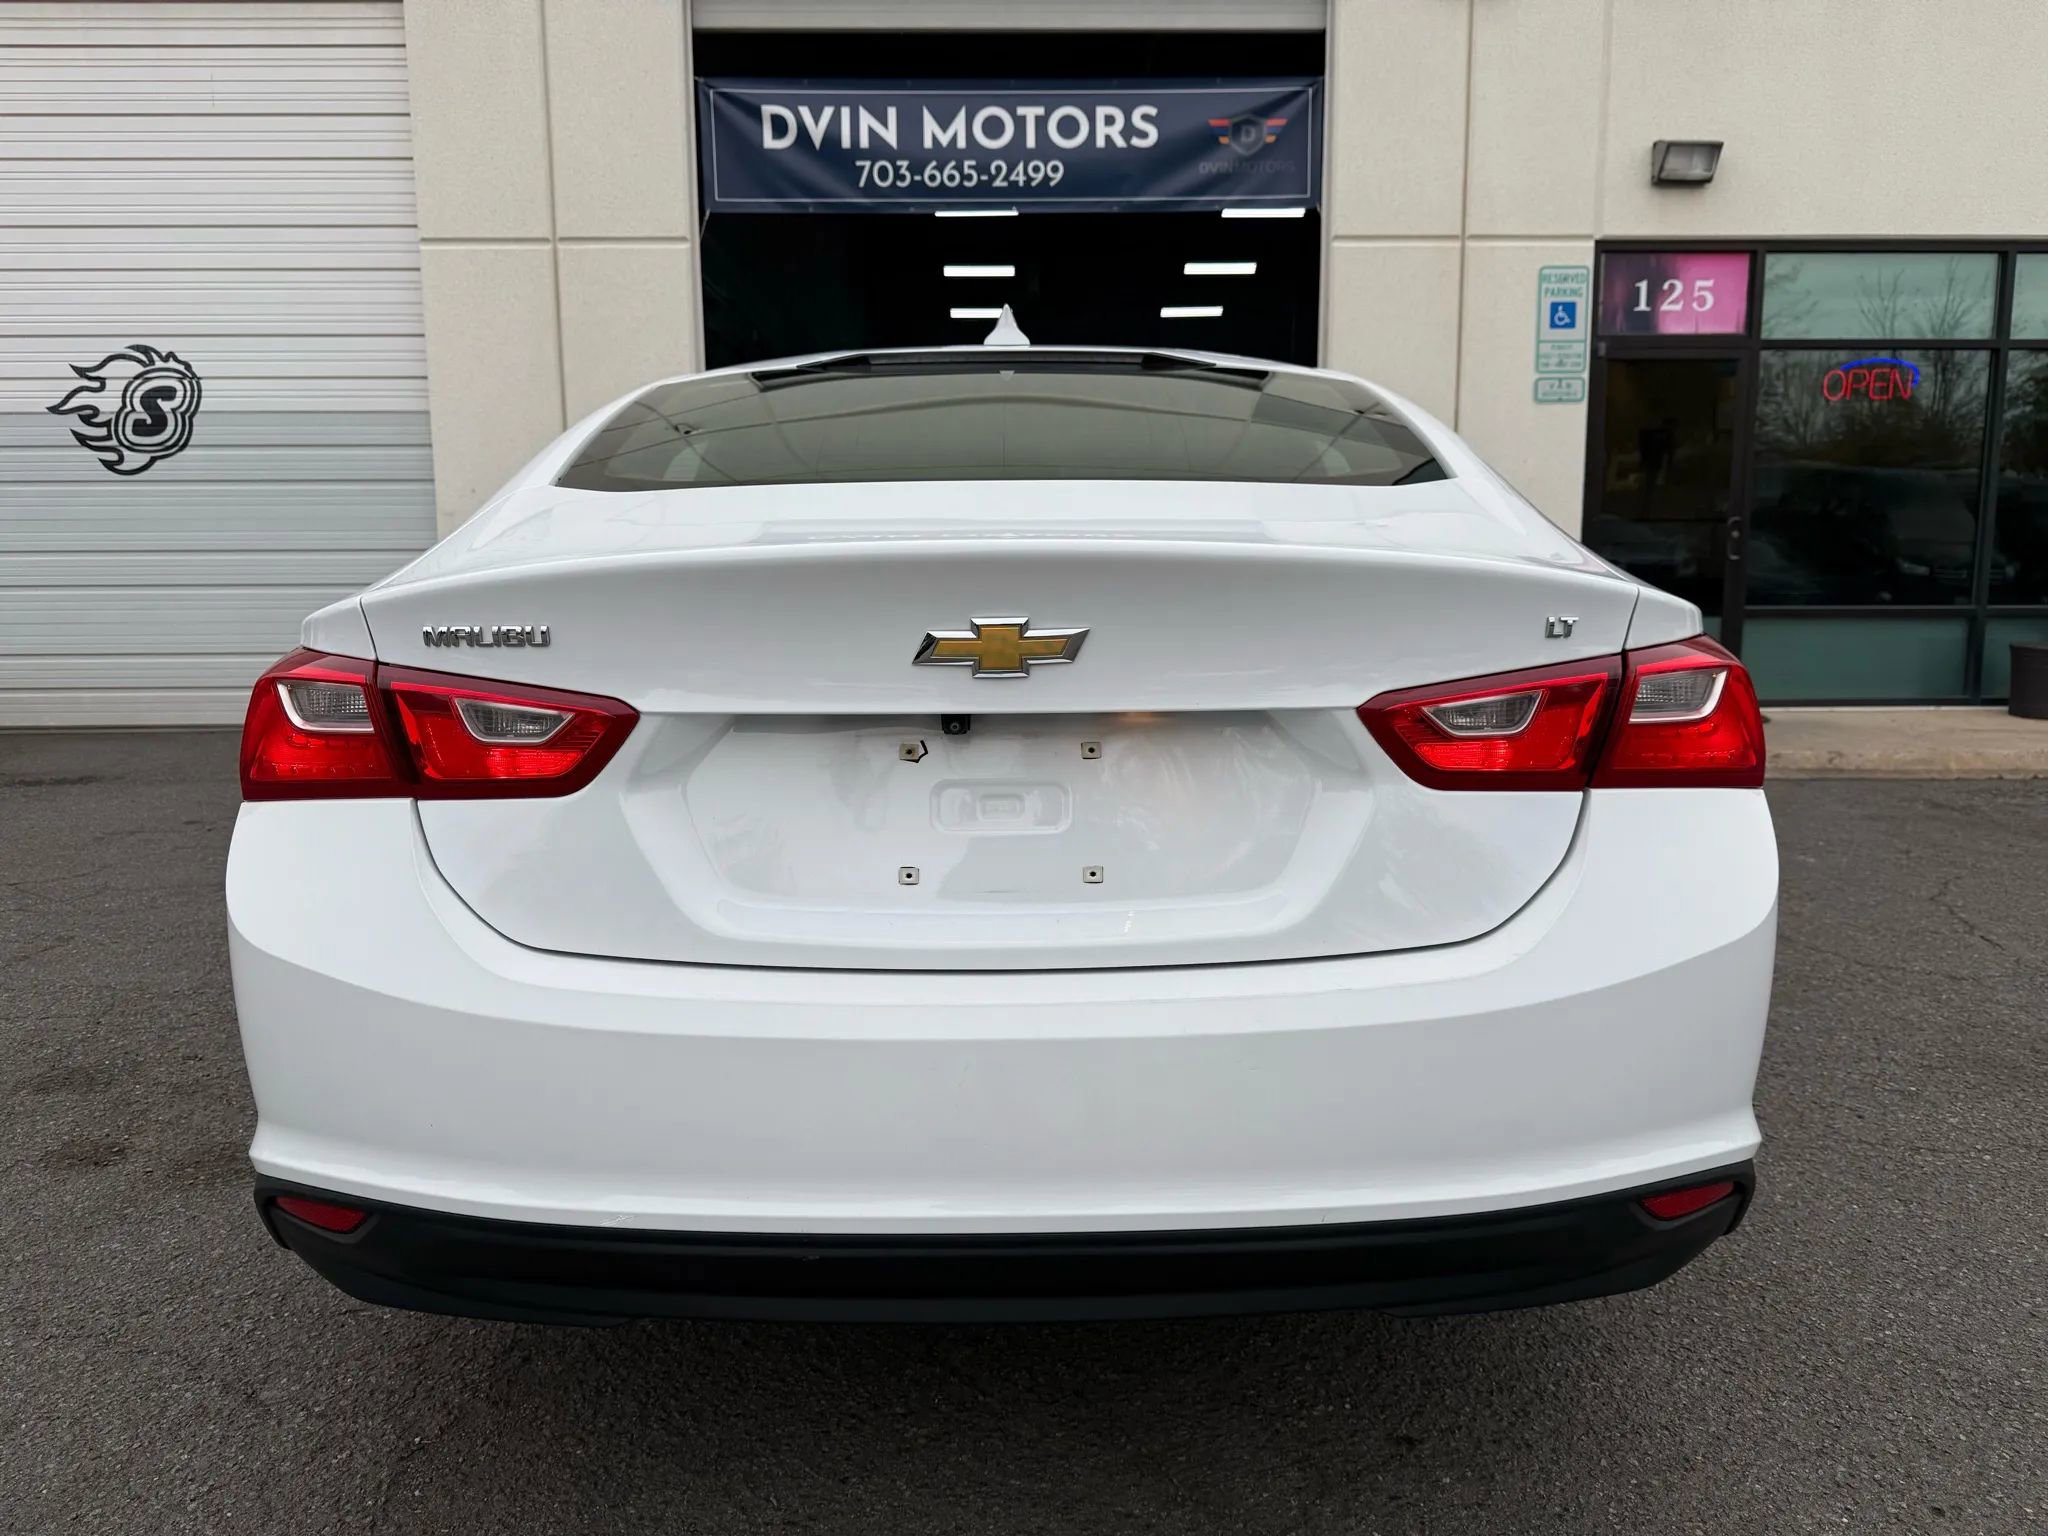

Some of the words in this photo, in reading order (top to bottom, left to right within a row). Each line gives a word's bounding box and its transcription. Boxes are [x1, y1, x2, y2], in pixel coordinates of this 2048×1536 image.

[761, 105, 898, 149] DVIN
[923, 104, 1159, 149] MOTORS
[855, 159, 1065, 188] 703-665-2499
[1544, 286, 1583, 298] PARKING
[1633, 279, 1715, 312] 125
[1823, 369, 1913, 401] OPEN
[422, 625, 551, 648] MALIBU
[1545, 616, 1579, 639] LT
